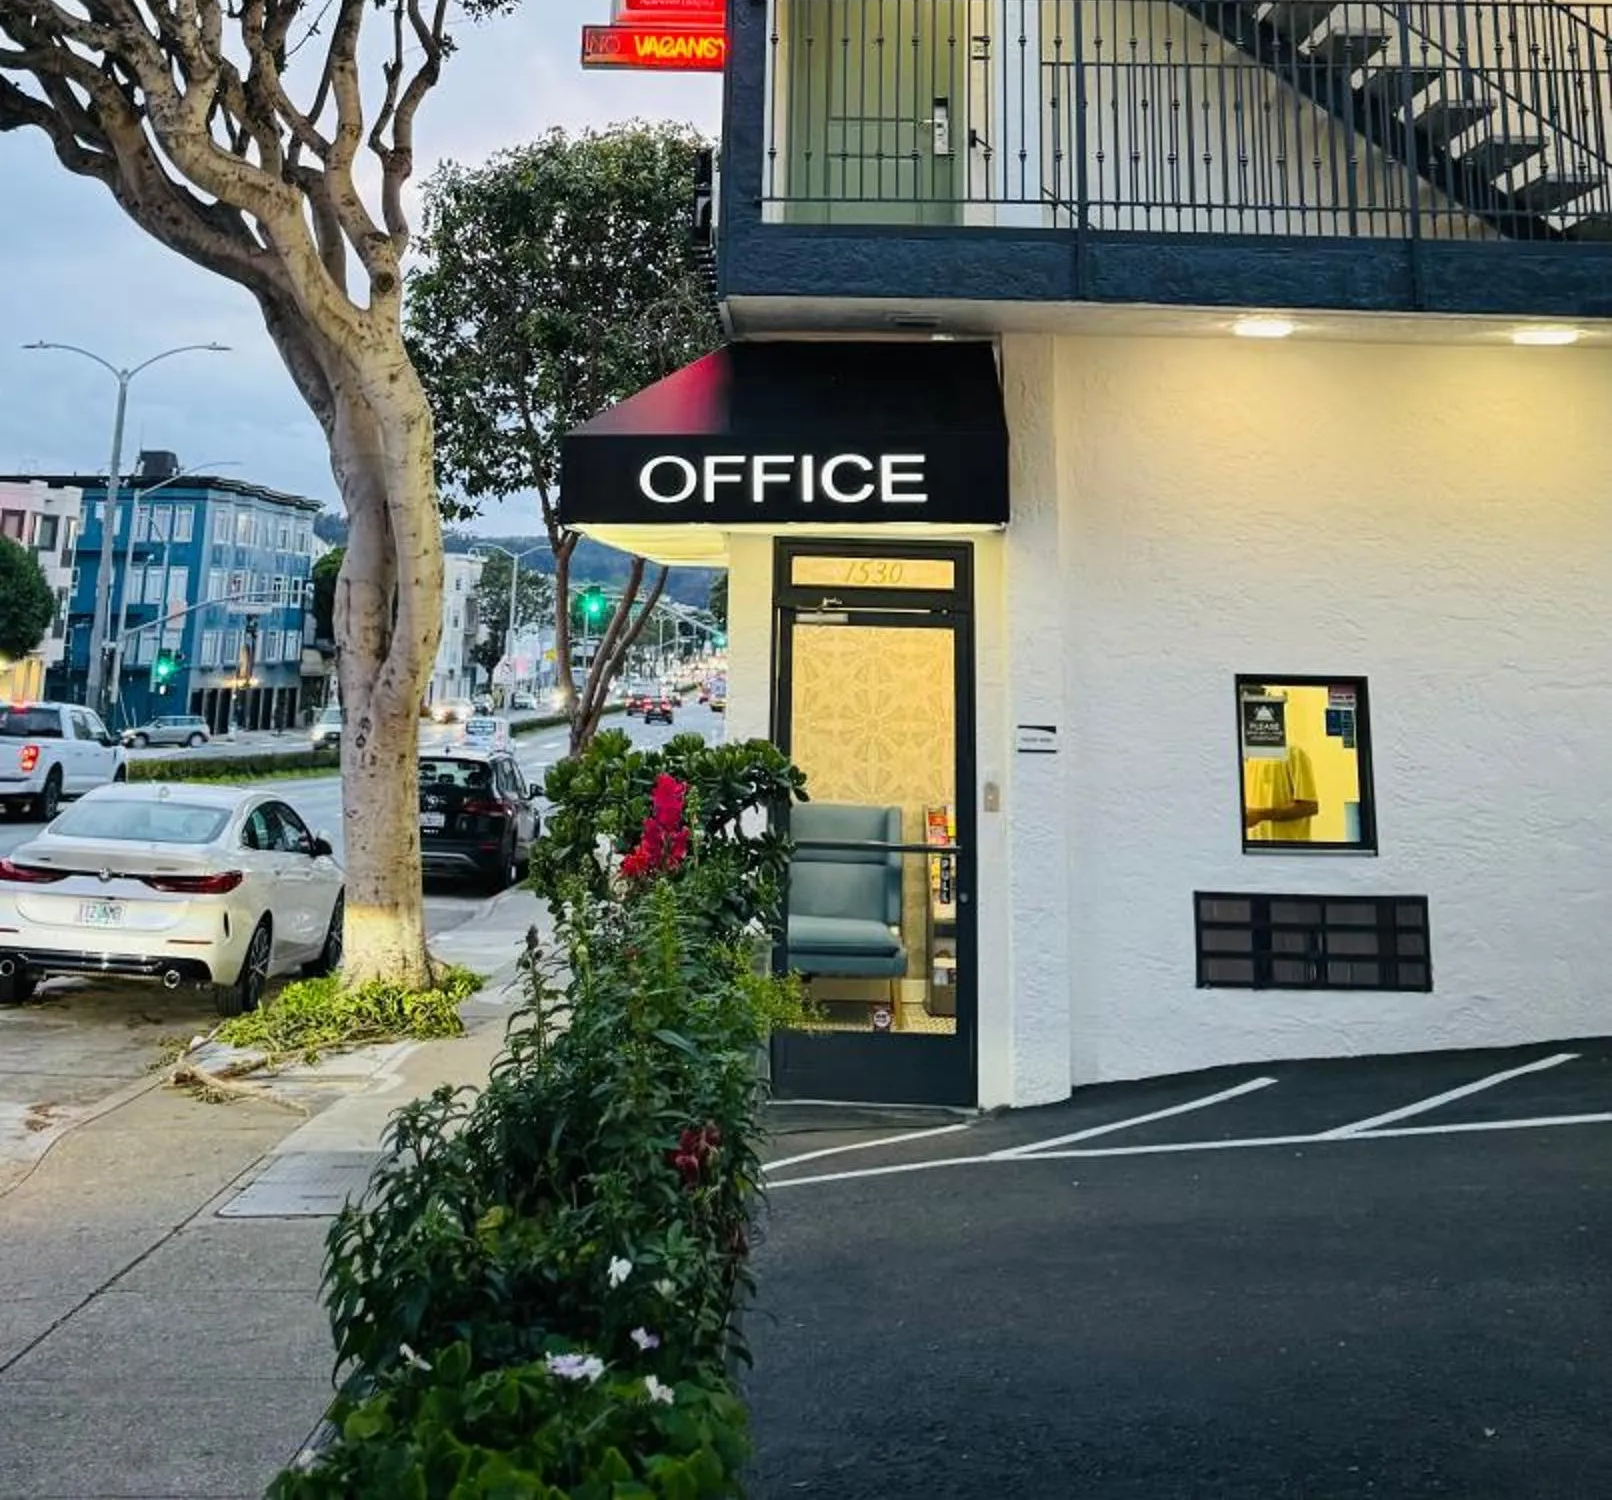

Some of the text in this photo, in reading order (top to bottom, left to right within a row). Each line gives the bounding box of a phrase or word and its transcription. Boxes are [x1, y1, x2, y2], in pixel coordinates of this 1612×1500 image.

[590, 35, 621, 54] NO
[638, 453, 928, 503] OFFICE
[845, 561, 903, 584] 1530
